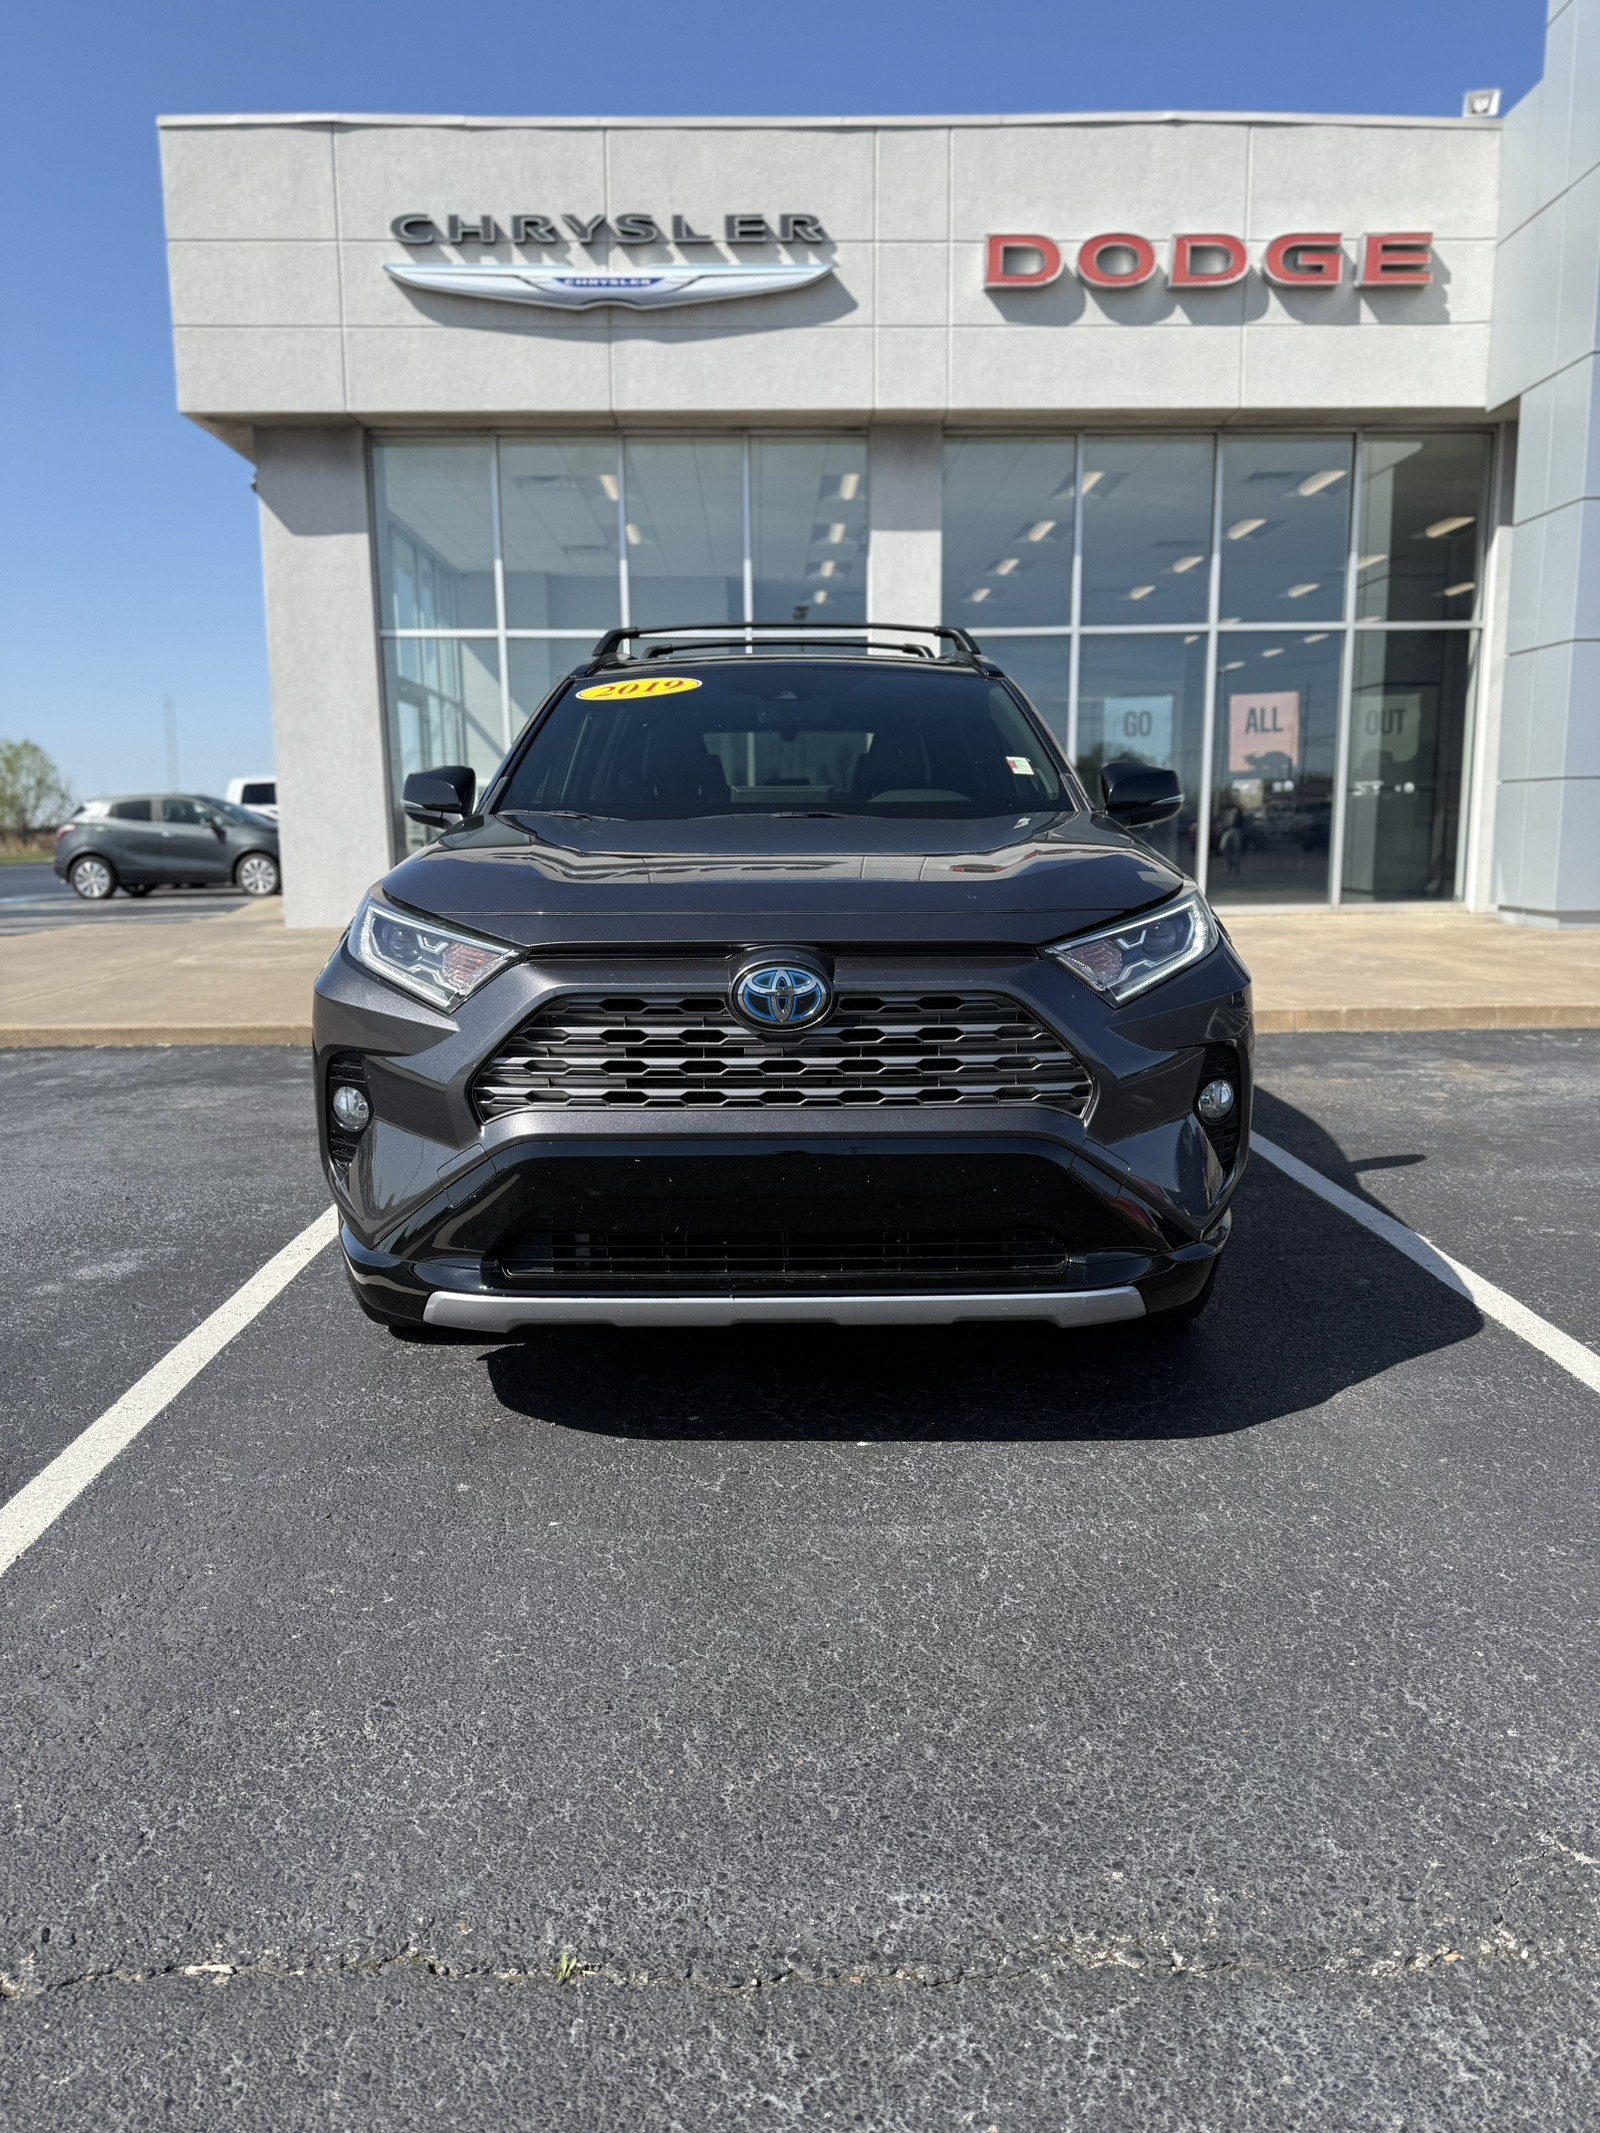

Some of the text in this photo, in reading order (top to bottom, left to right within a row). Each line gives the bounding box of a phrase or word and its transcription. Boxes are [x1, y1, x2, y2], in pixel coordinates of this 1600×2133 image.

[390, 213, 824, 244] CHRYSLER
[984, 232, 1433, 288] DODGE
[563, 277, 652, 287] CHRYSLER
[594, 680, 684, 697] 2019
[1123, 711, 1152, 737] GO
[1245, 706, 1284, 734] ALL
[1366, 708, 1407, 735] OUT
